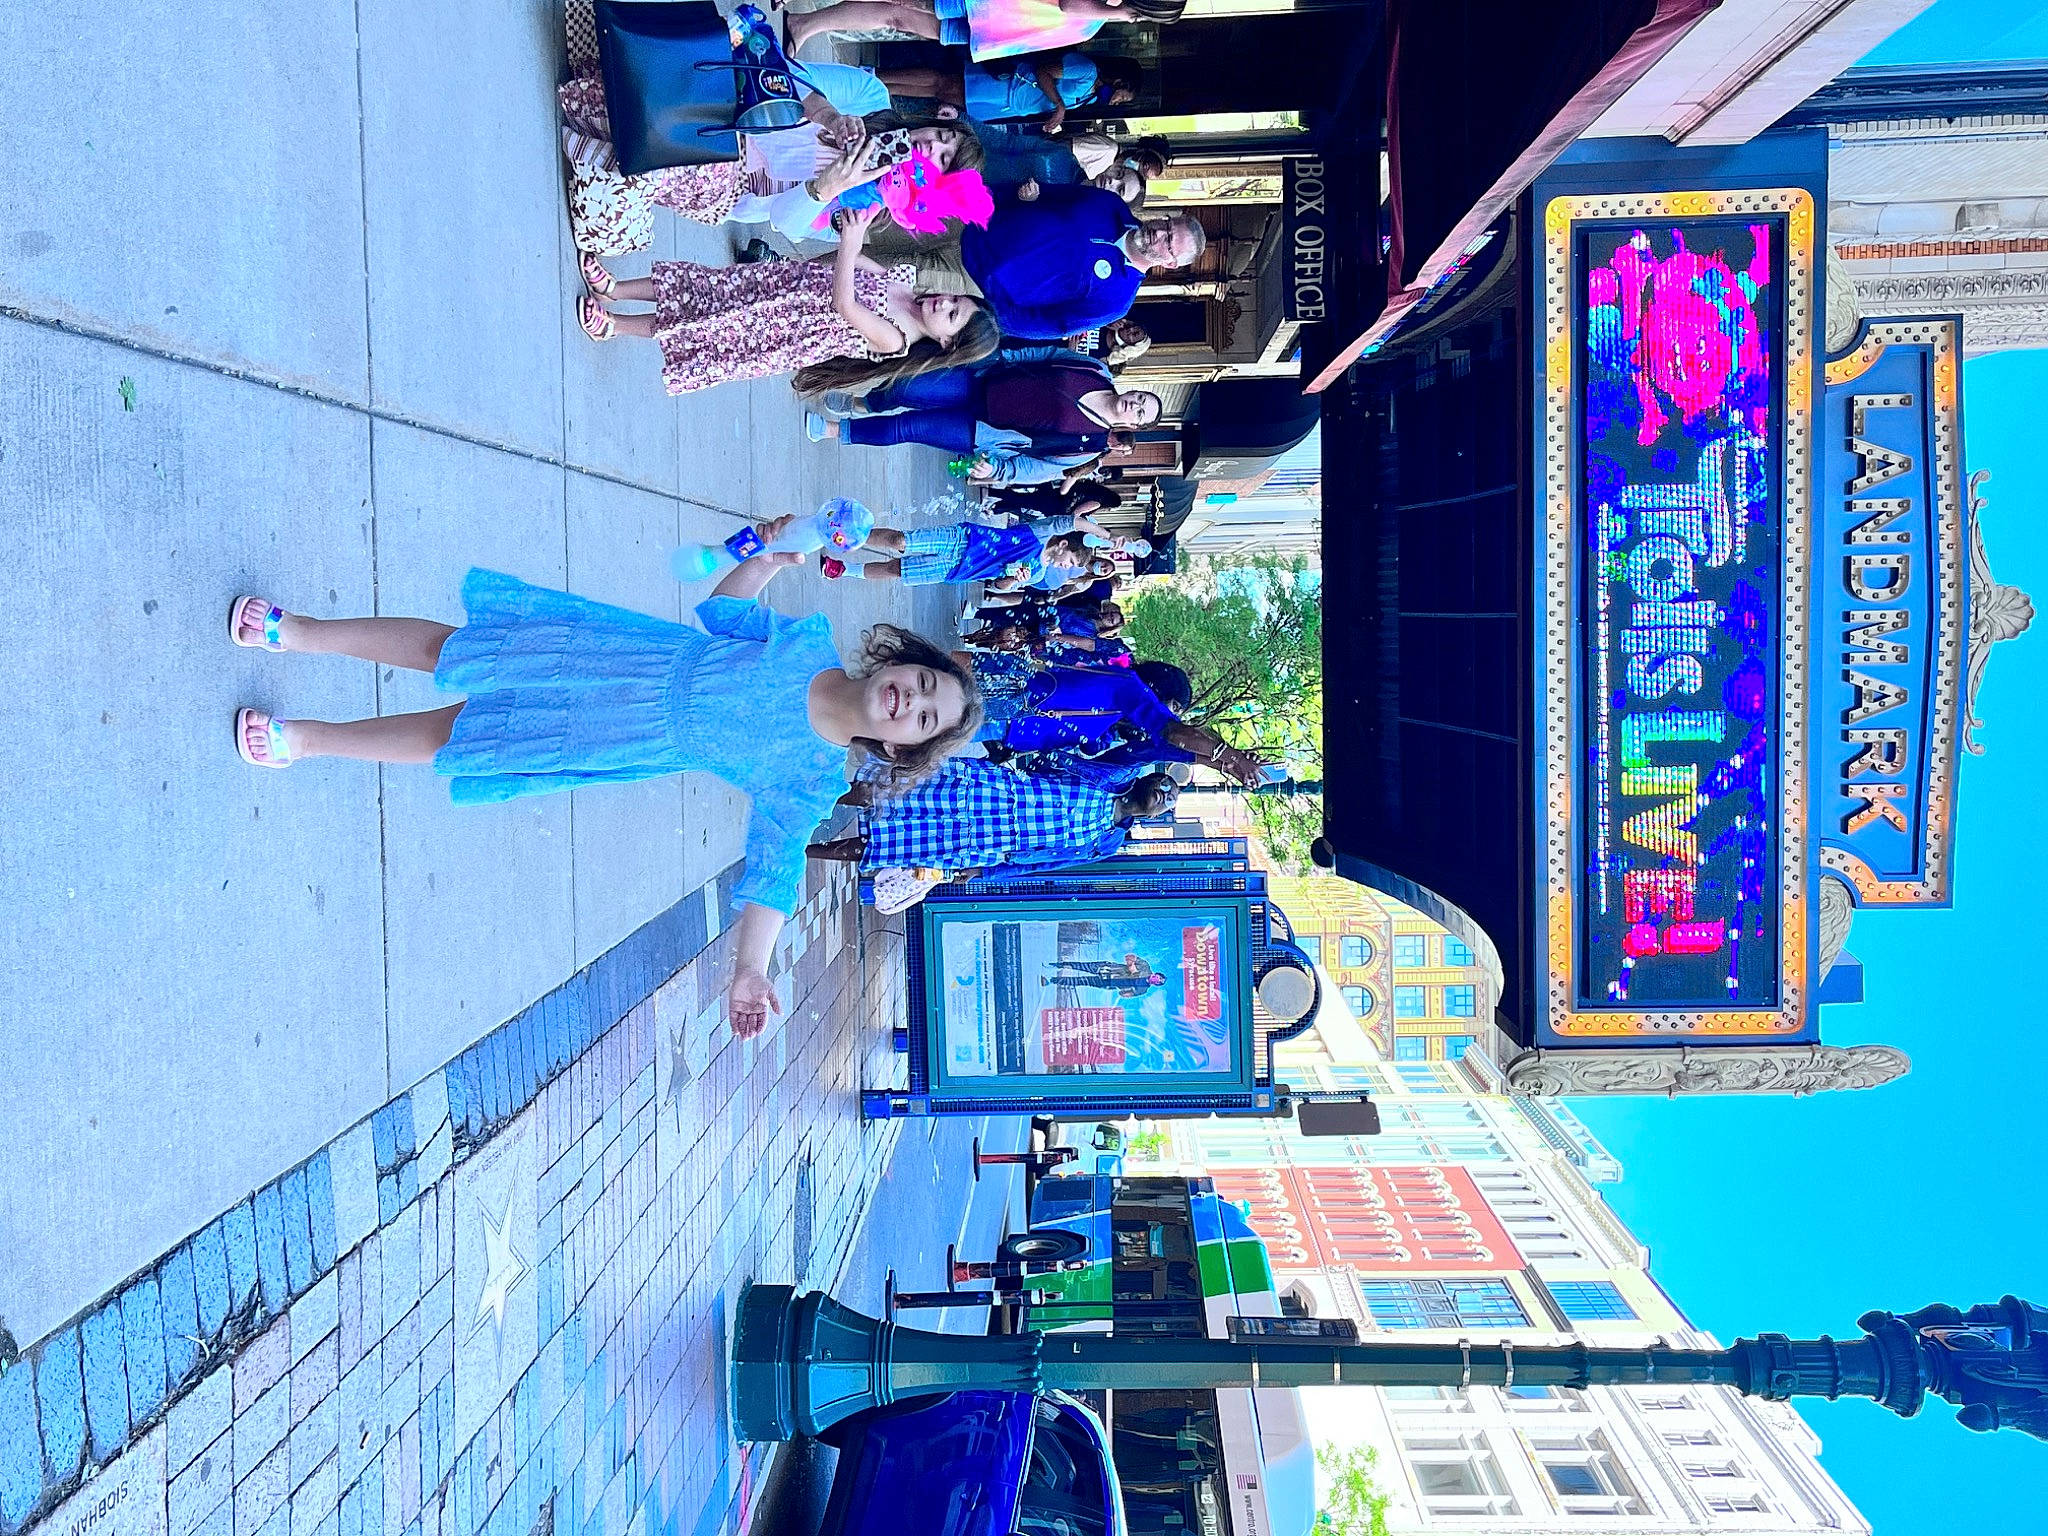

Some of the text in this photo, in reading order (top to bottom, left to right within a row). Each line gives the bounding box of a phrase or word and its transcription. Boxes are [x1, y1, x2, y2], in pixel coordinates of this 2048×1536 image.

[1294, 160, 1325, 319] BOX OFFICE
[1620, 437, 1732, 700] Trolls
[1844, 393, 1913, 835] LANDMARK
[1188, 958, 1196, 991] Syracuse
[1196, 932, 1208, 1016] Downtown
[1208, 961, 1216, 974] like
[70, 1480, 129, 1536] SIOBHAN
